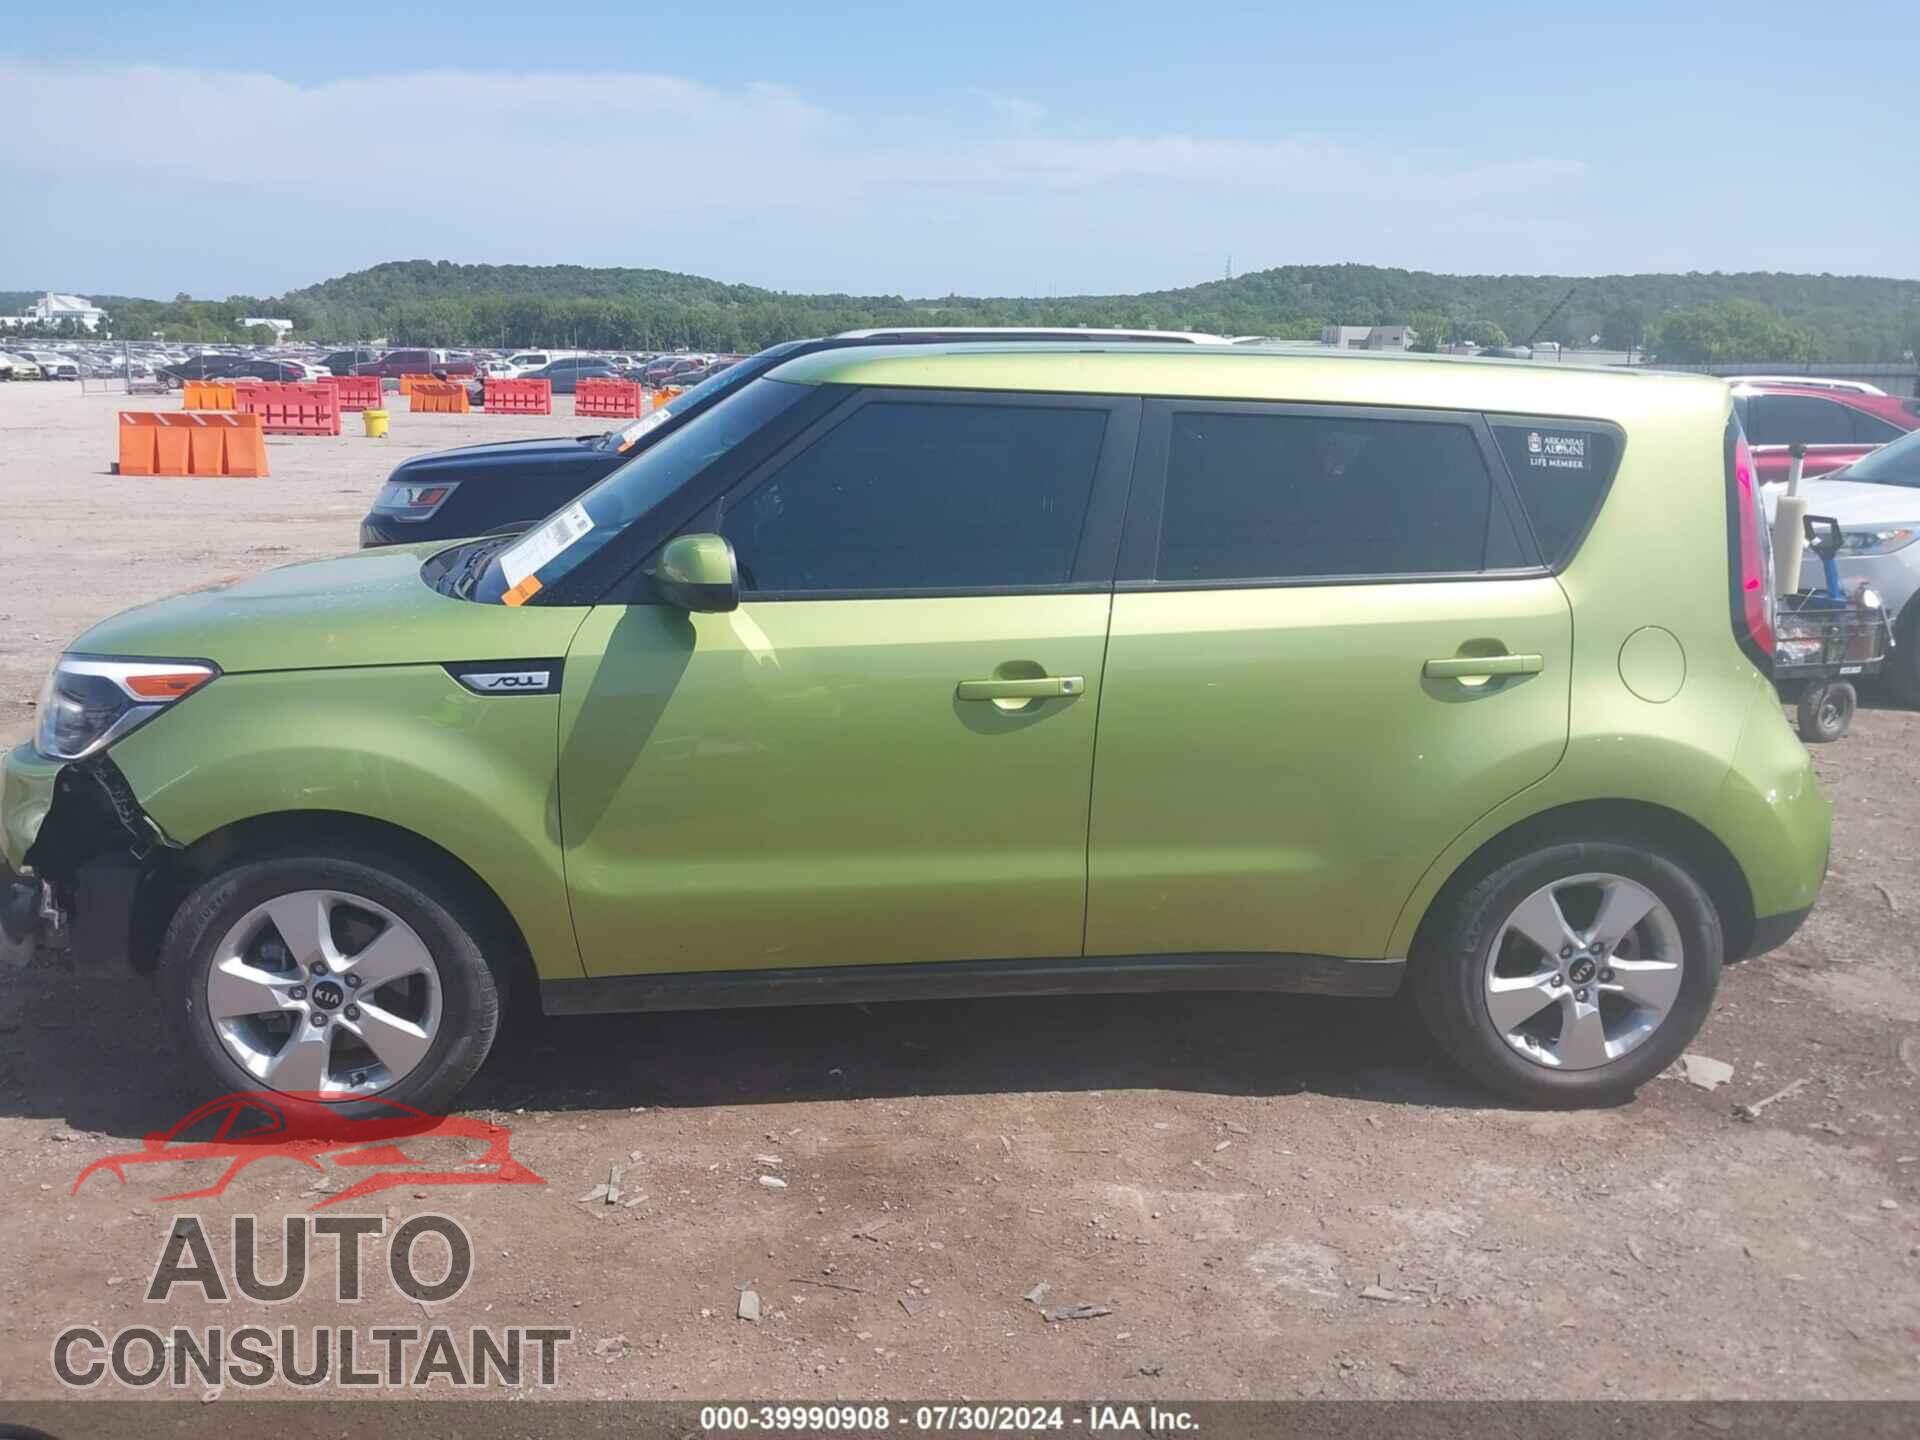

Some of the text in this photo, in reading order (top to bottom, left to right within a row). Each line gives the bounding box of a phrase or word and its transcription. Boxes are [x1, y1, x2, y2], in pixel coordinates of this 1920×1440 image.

[1544, 436, 1585, 446] ARKANSAS
[1544, 444, 1585, 456] ALUMNI
[1530, 457, 1584, 468] LIFE MEMBER
[489, 676, 543, 688] SOUL
[1572, 961, 1594, 981] KIA
[314, 988, 340, 1006] KIA
